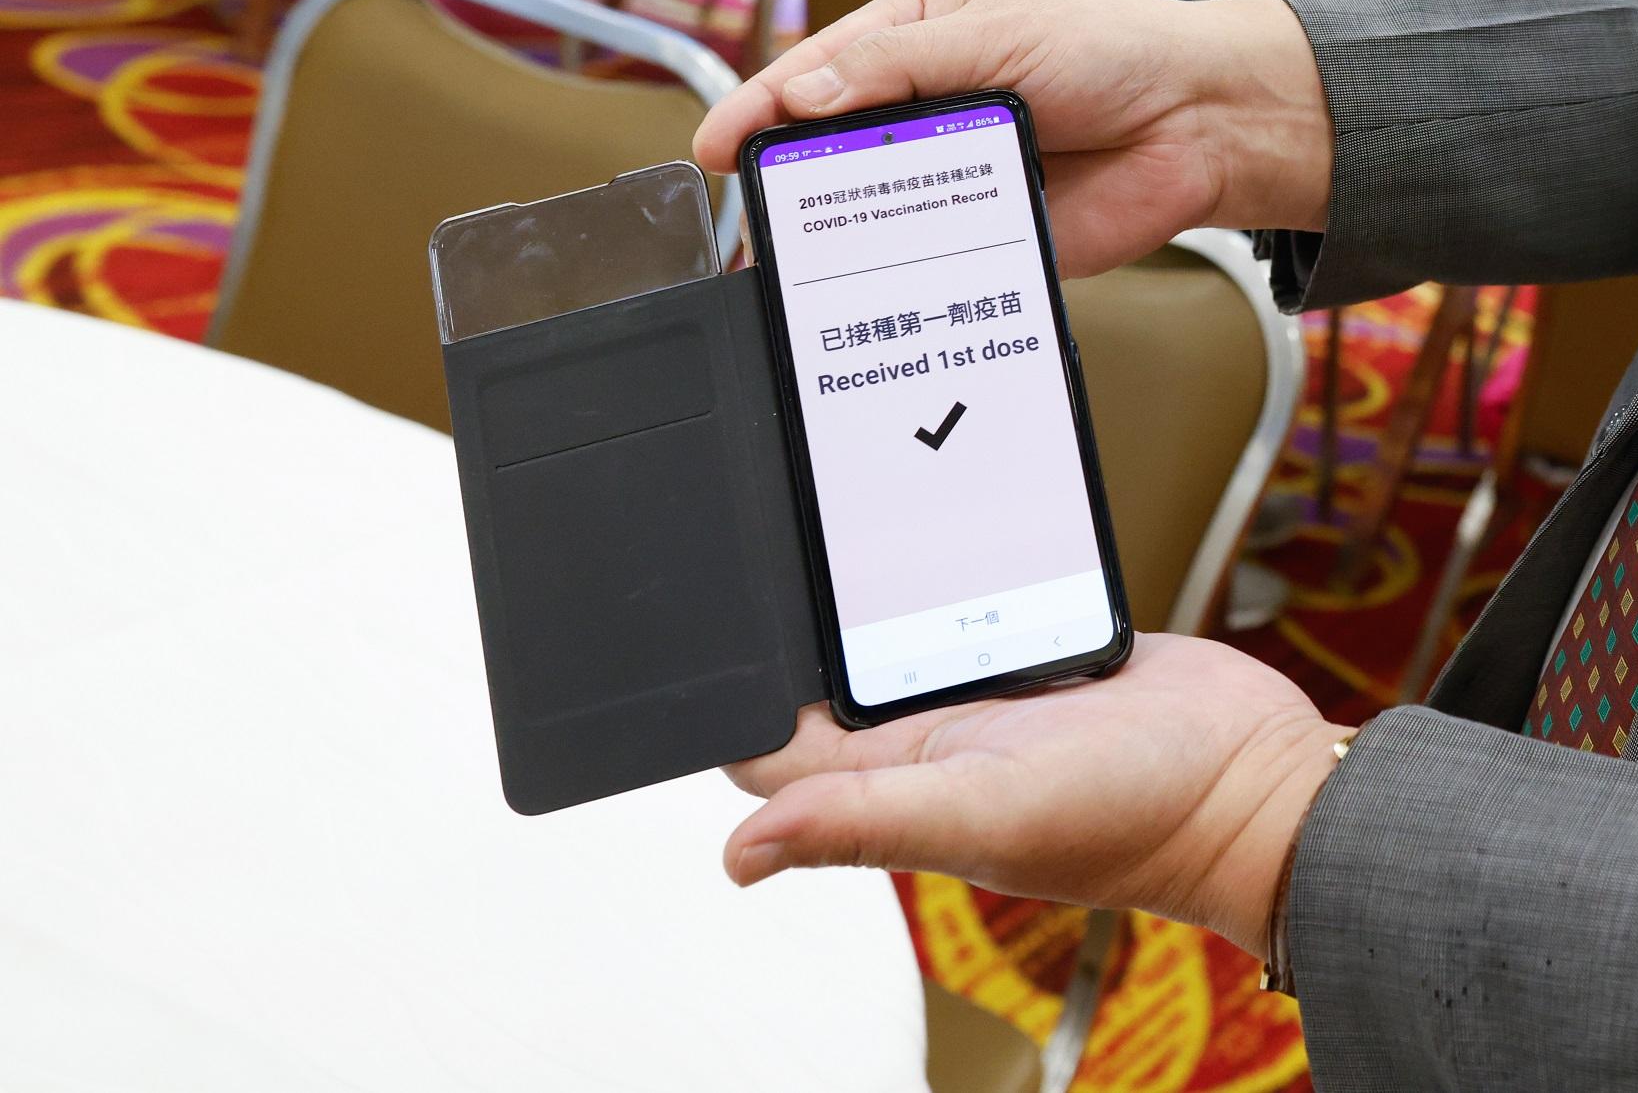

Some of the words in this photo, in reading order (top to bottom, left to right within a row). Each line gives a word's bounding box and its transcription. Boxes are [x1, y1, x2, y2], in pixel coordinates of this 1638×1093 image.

[975, 117, 994, 127] 86%
[774, 151, 800, 163] 09:59
[802, 212, 868, 234] COVID-19
[870, 197, 948, 221] Vaccination
[951, 187, 999, 206] Record
[819, 290, 1023, 352] 已接種第一劑疫苗
[817, 353, 930, 395] Received
[937, 345, 976, 371] 1st
[981, 336, 1040, 361] dose
[954, 610, 1000, 632] 下一個
